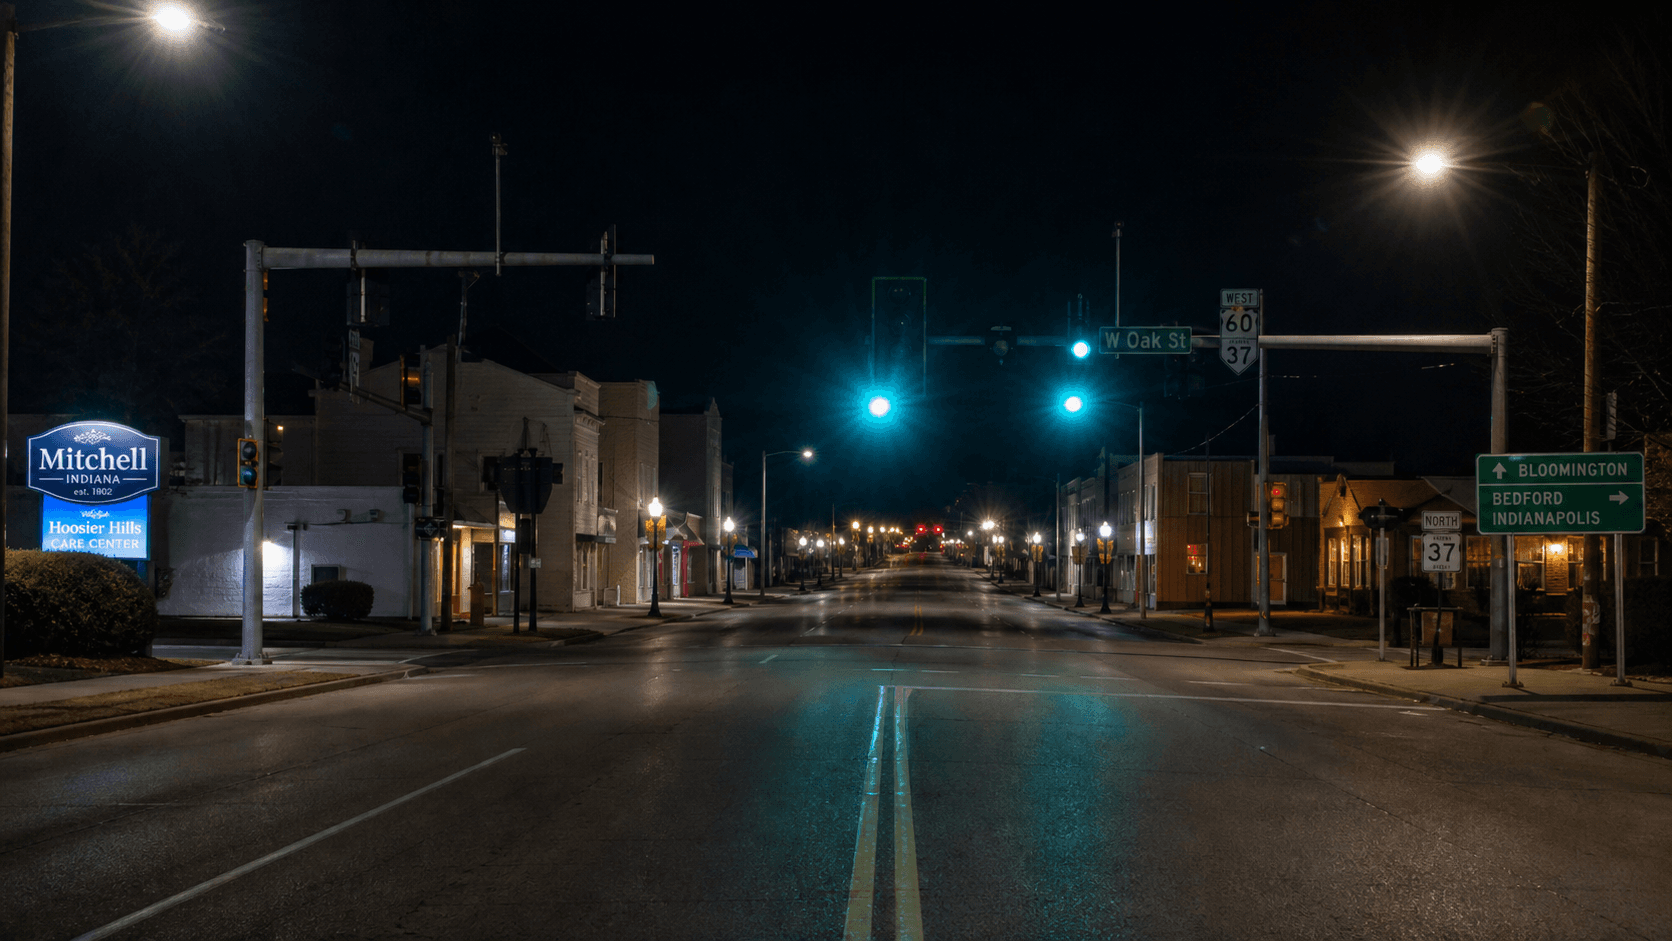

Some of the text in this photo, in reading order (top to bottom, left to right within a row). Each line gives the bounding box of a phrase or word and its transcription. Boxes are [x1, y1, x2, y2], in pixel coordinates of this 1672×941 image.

[1226, 293, 1253, 304] WEST
[1226, 314, 1252, 332] 60
[1105, 331, 1187, 349] W Oak St
[1227, 346, 1252, 365] 37
[39, 447, 148, 471] Mitchell
[1518, 462, 1628, 478] BLOOMINGTON
[66, 474, 120, 484] INDIANA
[1493, 491, 1563, 506] BEDFORD
[1425, 516, 1458, 526] NORTH
[1492, 511, 1600, 526] INDIANAPOLIS
[49, 521, 142, 535] Hoosier Hills
[50, 539, 139, 549] CARE CENTER
[1428, 543, 1455, 562] 37
